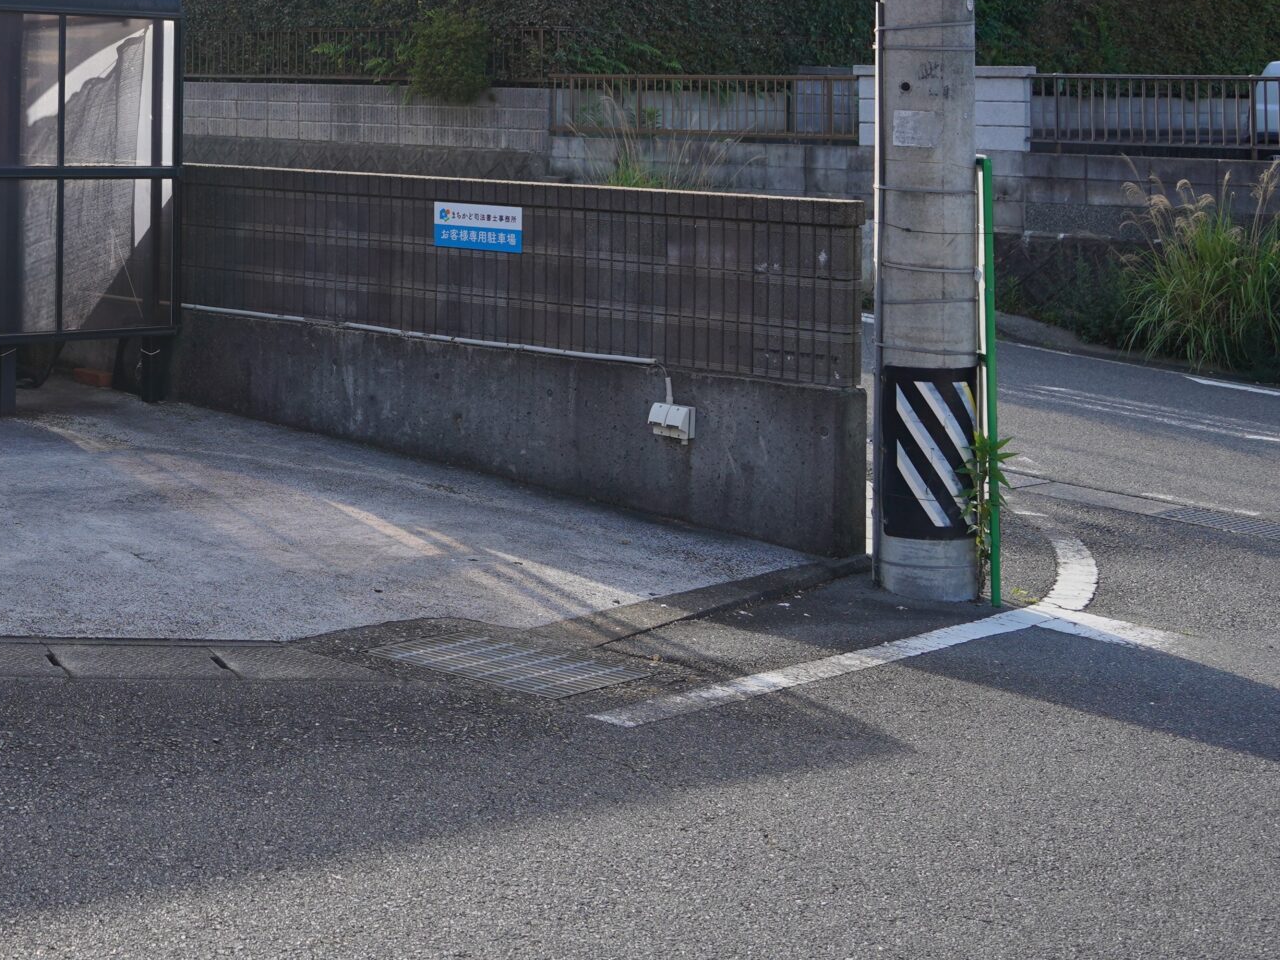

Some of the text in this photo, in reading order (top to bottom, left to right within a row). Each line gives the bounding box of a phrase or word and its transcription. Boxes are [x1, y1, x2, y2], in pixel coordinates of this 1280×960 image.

[451, 211, 517, 224] まちかど司法書士事務所
[440, 229, 517, 246] お客様専用駐車場
